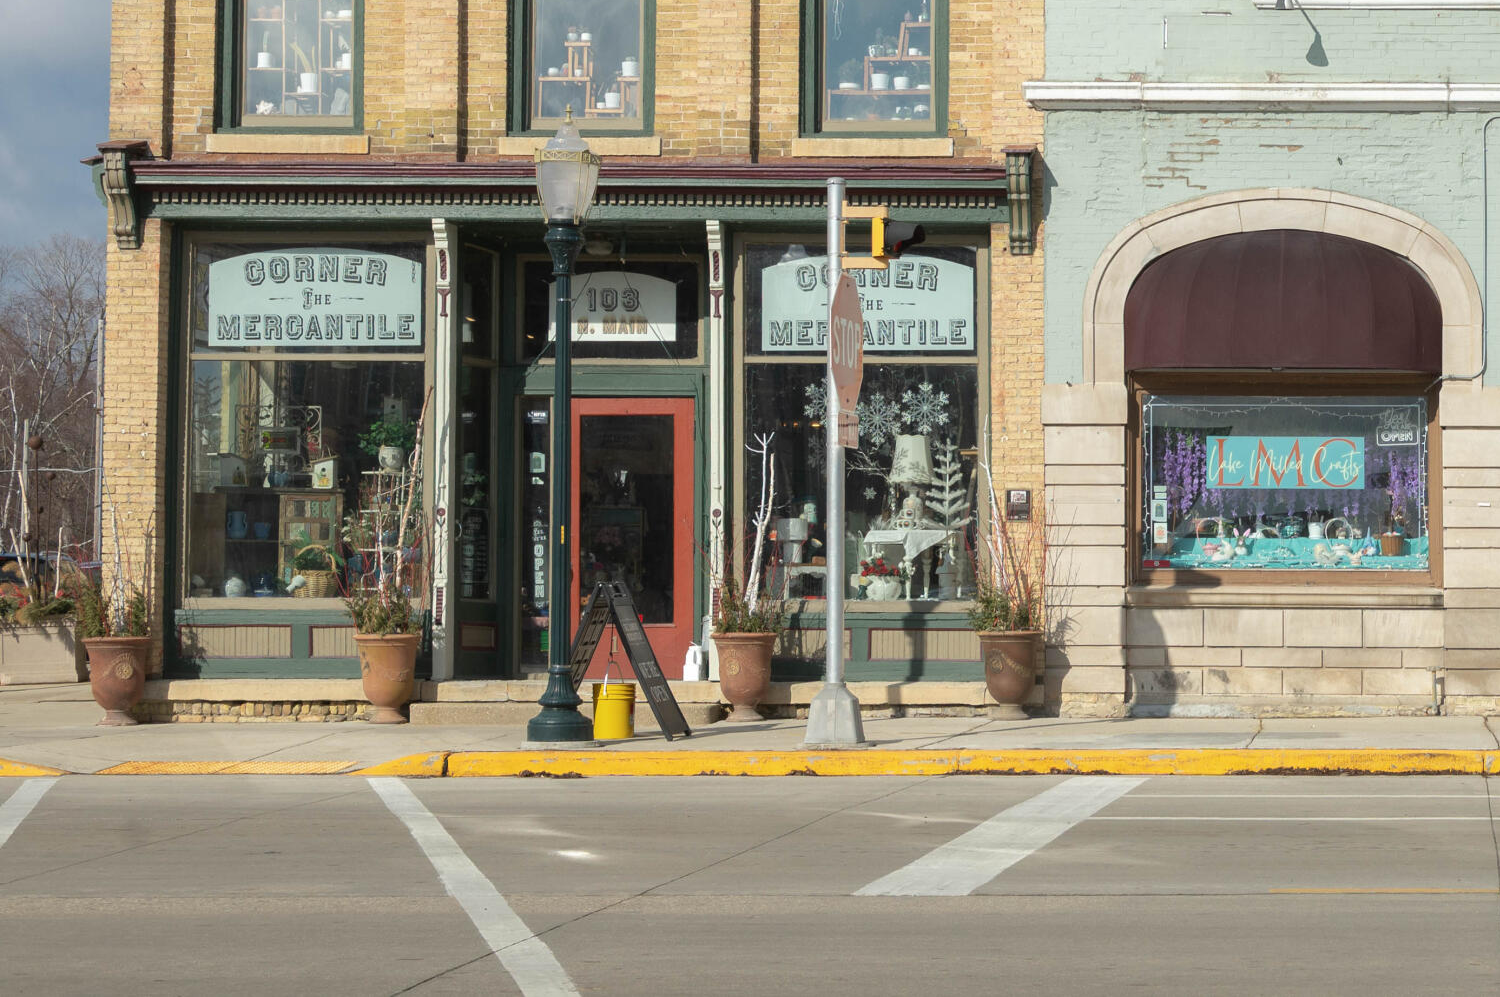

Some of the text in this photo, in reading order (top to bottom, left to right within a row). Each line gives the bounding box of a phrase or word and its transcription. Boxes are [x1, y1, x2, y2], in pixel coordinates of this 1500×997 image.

[245, 255, 388, 286] CORNER
[796, 261, 938, 291] CRNER
[587, 287, 640, 312] 103
[216, 313, 415, 340] MERCANTILE
[577, 314, 649, 335] N. MAIN
[769, 318, 967, 346] MERANTILE
[833, 315, 861, 369] STOP
[1381, 430, 1413, 442] OPEN
[1209, 445, 1244, 482] Lake
[1310, 446, 1364, 484] Crafts
[1215, 437, 1359, 488] LMC
[533, 543, 545, 598] OPEN
